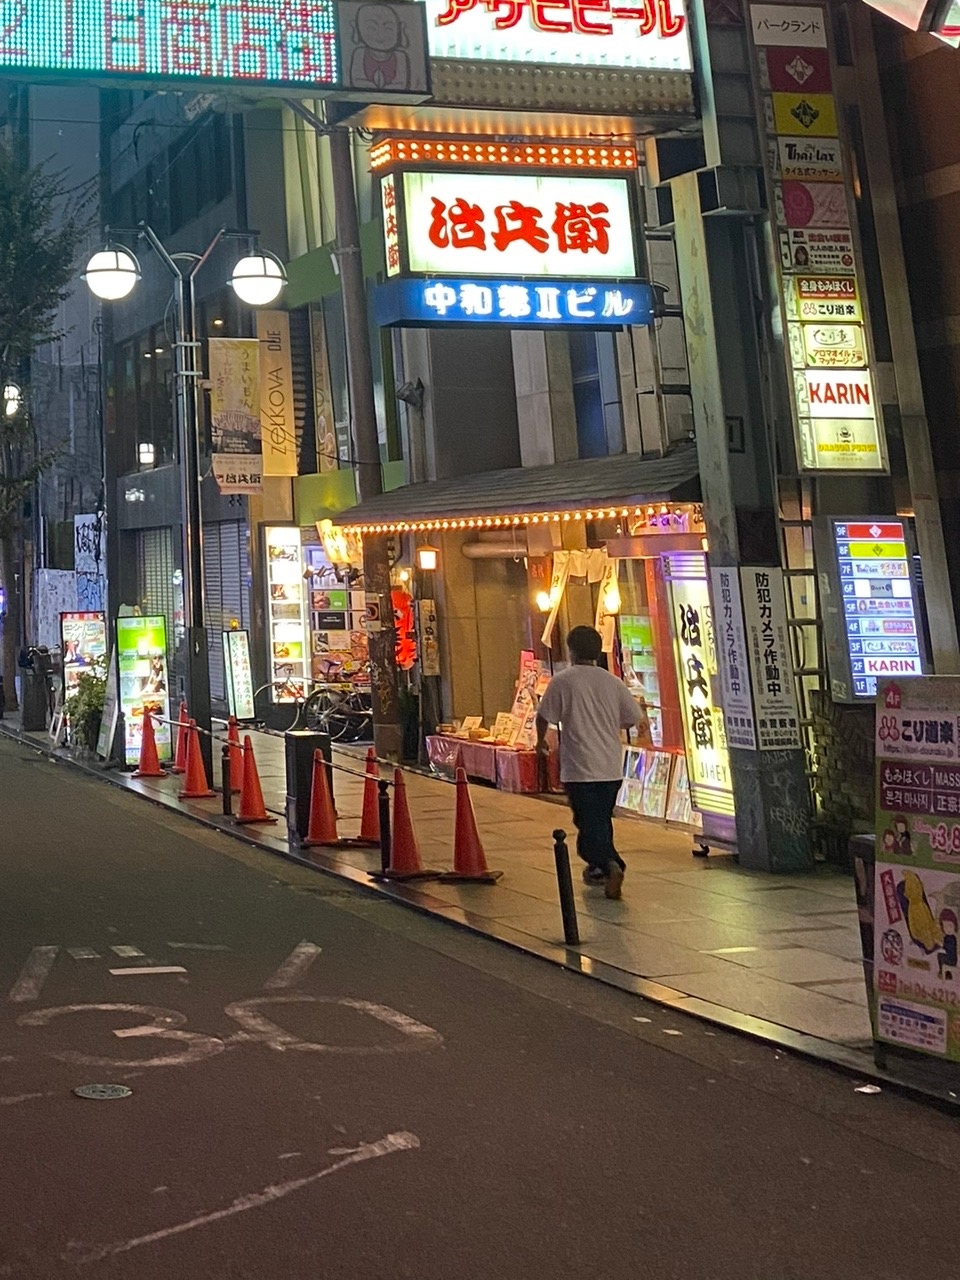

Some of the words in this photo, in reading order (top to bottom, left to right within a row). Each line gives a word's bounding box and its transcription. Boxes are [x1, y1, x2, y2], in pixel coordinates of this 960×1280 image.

[809, 382, 870, 405] KARIN
[836, 527, 846, 535] 9F
[839, 546, 848, 554] 8F
[842, 565, 851, 574] 7F
[844, 584, 853, 592] 6F
[846, 603, 856, 612] 5F
[848, 623, 858, 631] 4F
[720, 573, 740, 696] 防犯カメラ作動中
[755, 572, 781, 697] 防犯カメラ作動中
[852, 642, 860, 651] 3F
[853, 661, 863, 671] 2F
[868, 660, 916, 672] KARIN
[856, 681, 865, 690] 1F
[886, 691, 900, 706] 4F
